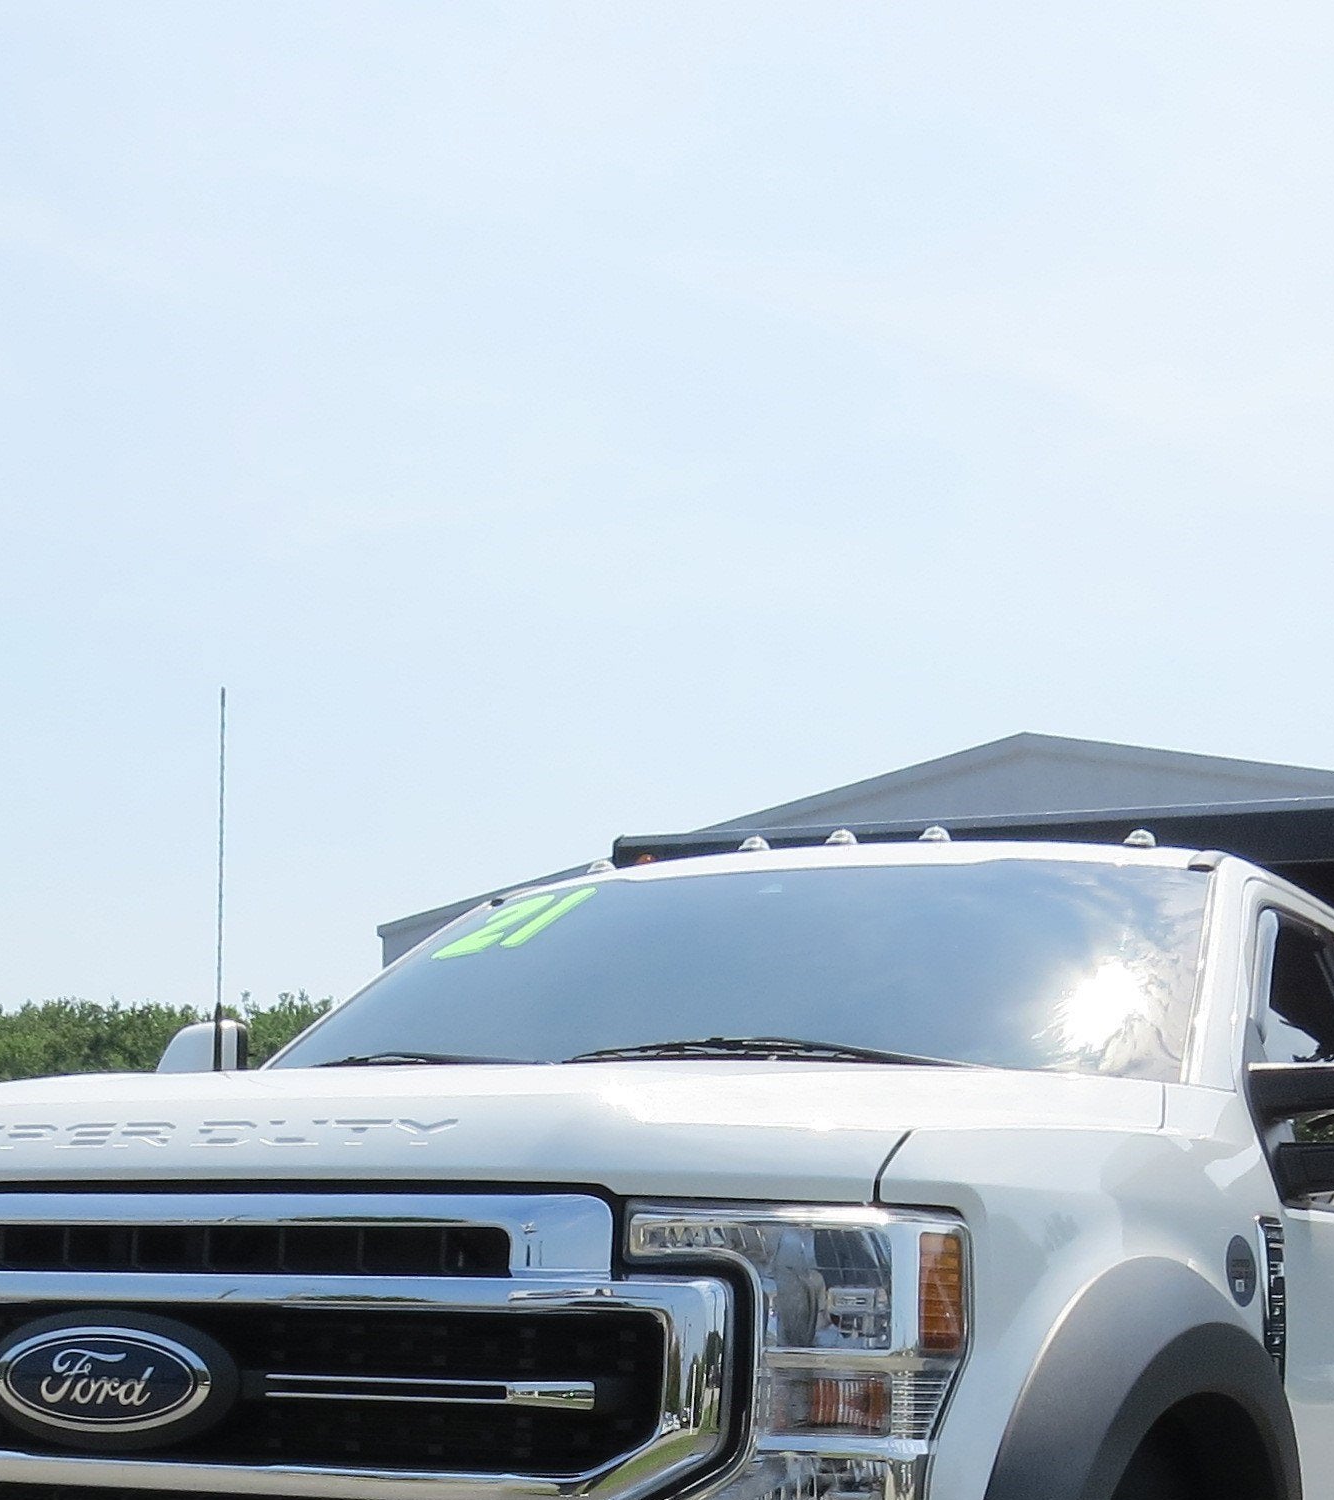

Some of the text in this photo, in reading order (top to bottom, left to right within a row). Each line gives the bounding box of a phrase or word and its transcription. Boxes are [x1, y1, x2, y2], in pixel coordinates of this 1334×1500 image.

[430, 887, 598, 960] 21
[189, 1118, 460, 1148] DUTY
[40, 1348, 155, 1407] Ford
